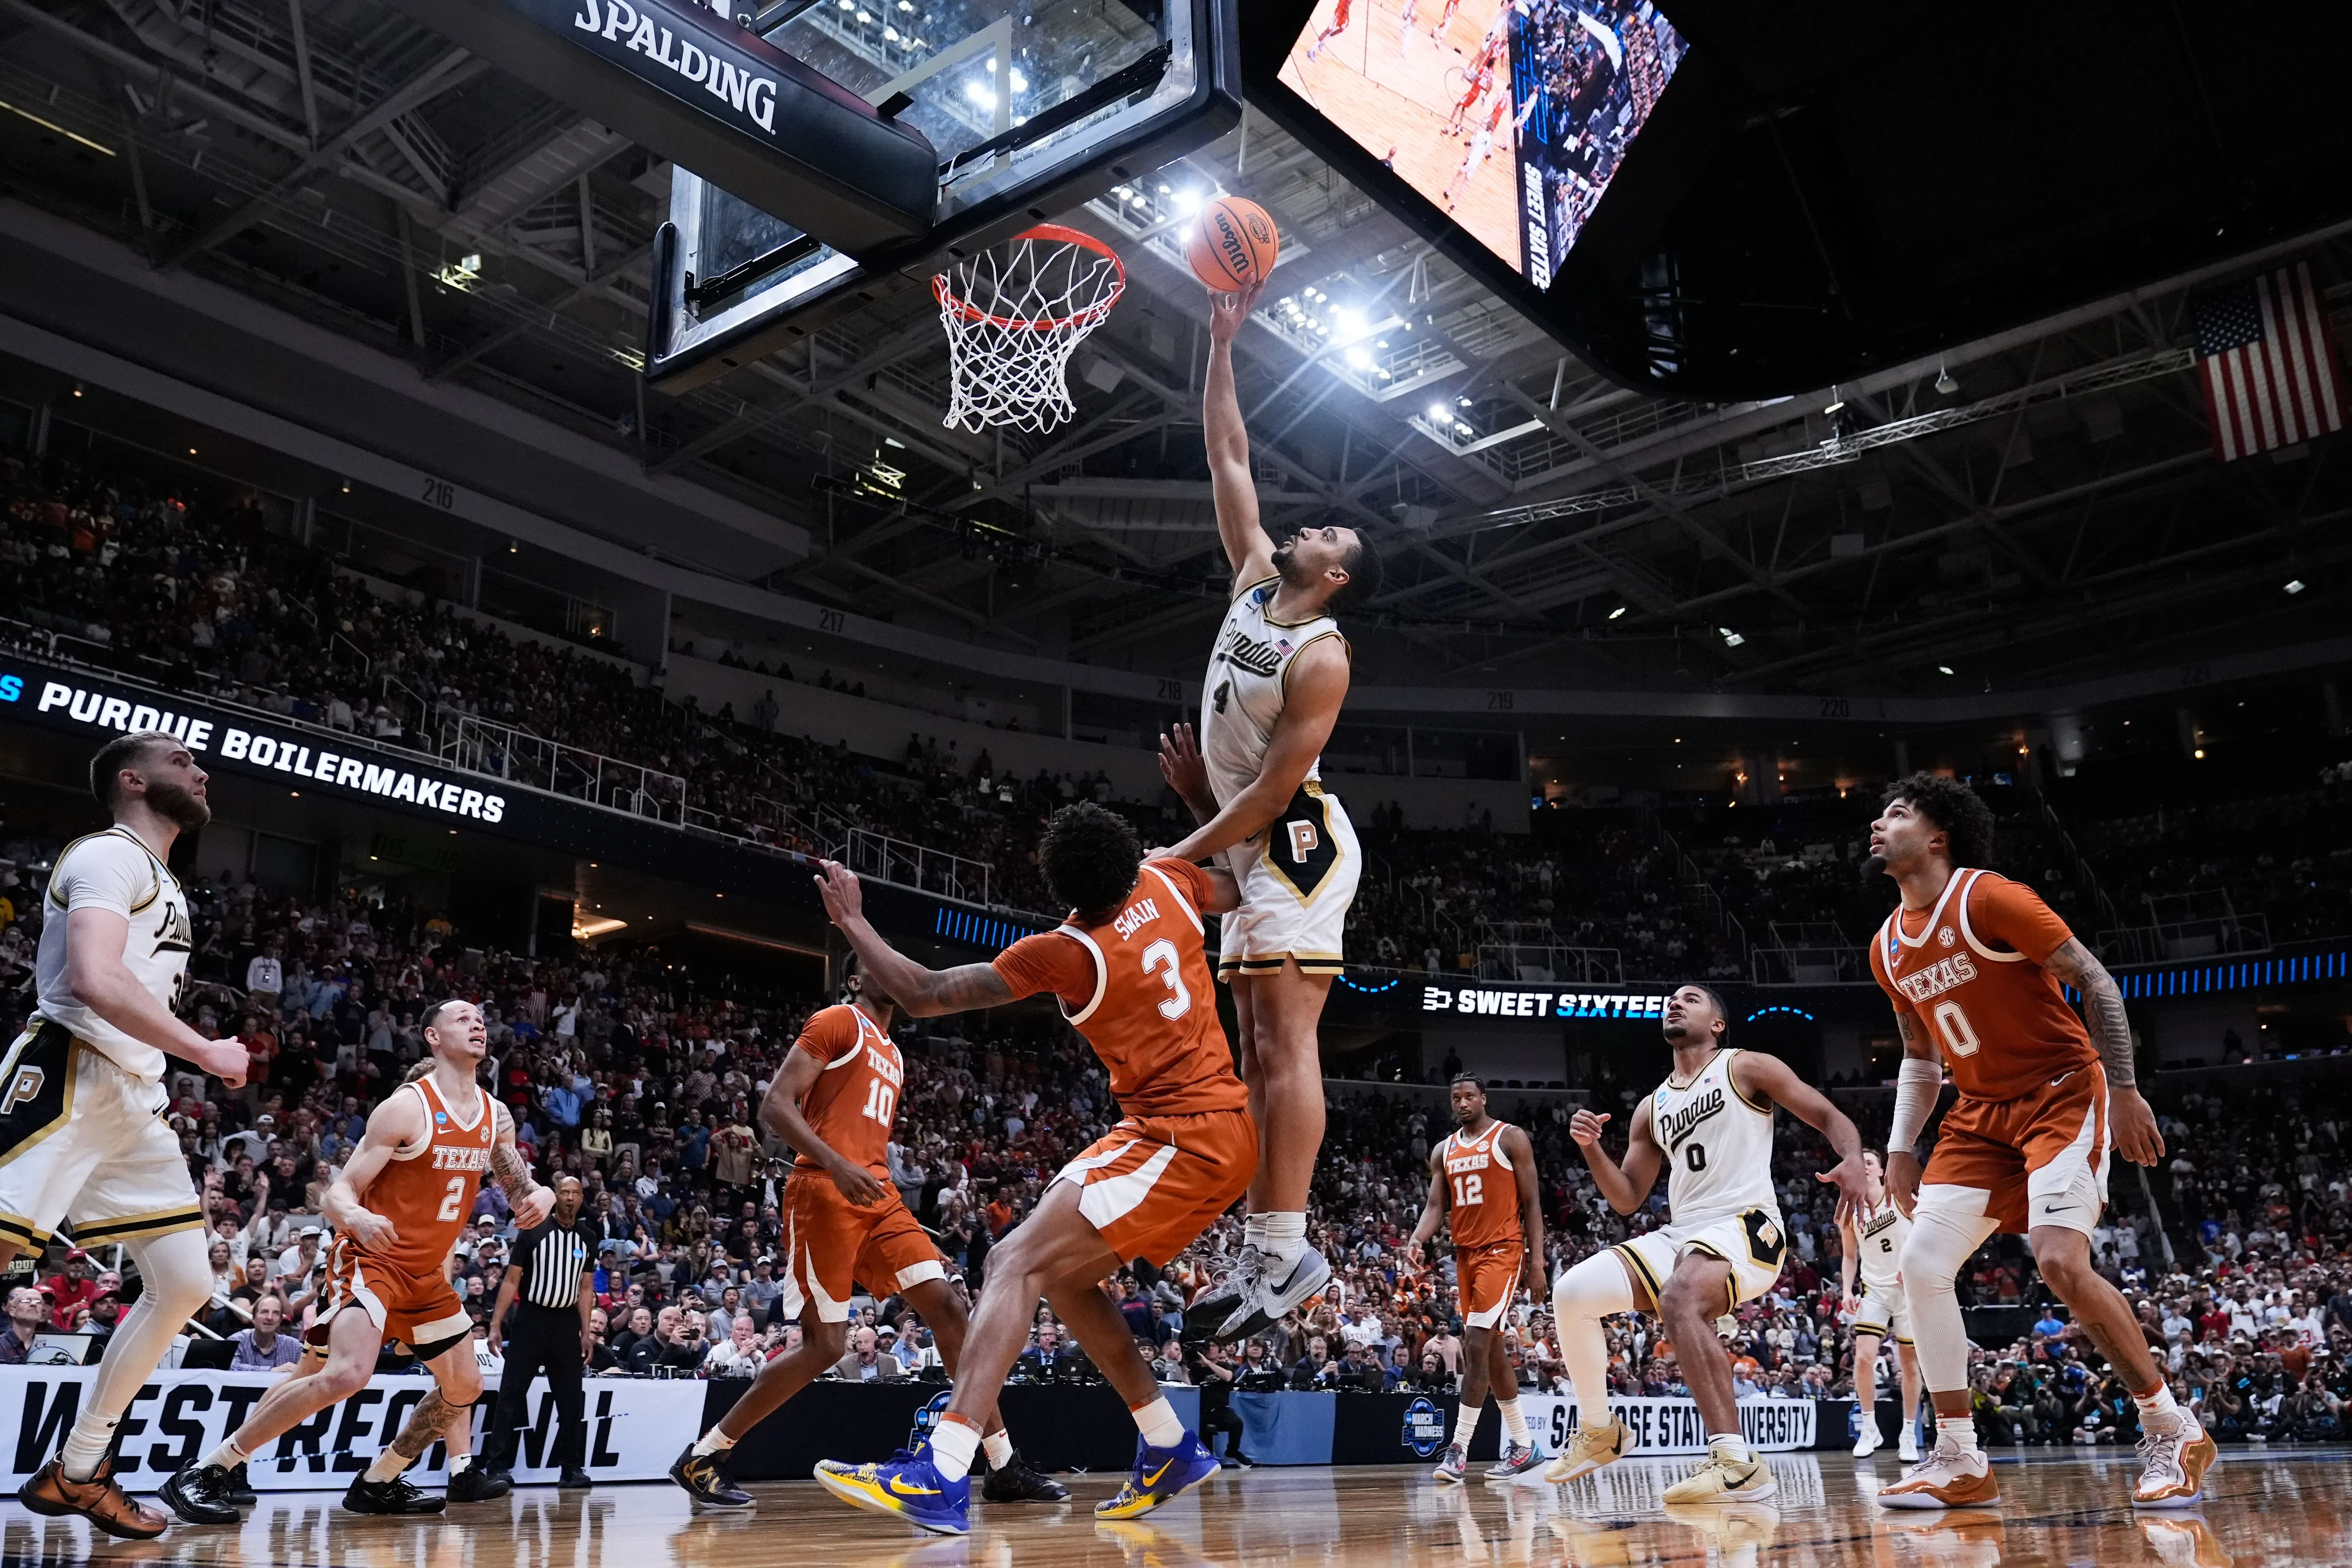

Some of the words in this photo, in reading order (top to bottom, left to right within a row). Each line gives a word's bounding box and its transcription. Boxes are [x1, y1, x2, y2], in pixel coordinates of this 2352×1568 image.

[575, 0, 777, 132] SPALDING
[1524, 162, 1546, 227] SWEET
[1214, 212, 1250, 274] Wilson
[1529, 221, 1551, 292] SIXTEE
[423, 477, 453, 509] 216
[820, 608, 845, 633] 217
[1219, 618, 1283, 671] Purdue
[1158, 678, 1182, 700] 218
[1214, 679, 1230, 715] 4
[38, 681, 214, 751] PURDUE
[220, 728, 505, 823] BOILERMAKERS
[1286, 819, 1319, 863] P
[1114, 898, 1160, 941] SWAIN
[1142, 938, 1191, 1021] 3
[1897, 951, 1977, 1004] TEXAS
[1457, 989, 1553, 1017] SWEET
[1934, 1000, 1980, 1058] 0
[867, 1045, 901, 1089] TEXAS
[1, 1065, 45, 1114] P
[862, 1077, 894, 1128] 10
[1659, 1088, 1724, 1145] Purdue
[432, 1144, 490, 1171] TEXAS
[1446, 1153, 1489, 1175] TEXAS
[1685, 1142, 1706, 1172] 0
[436, 1176, 466, 1221] 2
[1454, 1174, 1484, 1207] 12
[8, 1259, 36, 1270] RDUE
[1880, 1238, 1892, 1252] 2
[1537, 1416, 1547, 1429] BY
[1551, 1405, 1581, 1449] SA
[1659, 1406, 1708, 1447] STAT
[1736, 1406, 1810, 1444] IVERSITY
